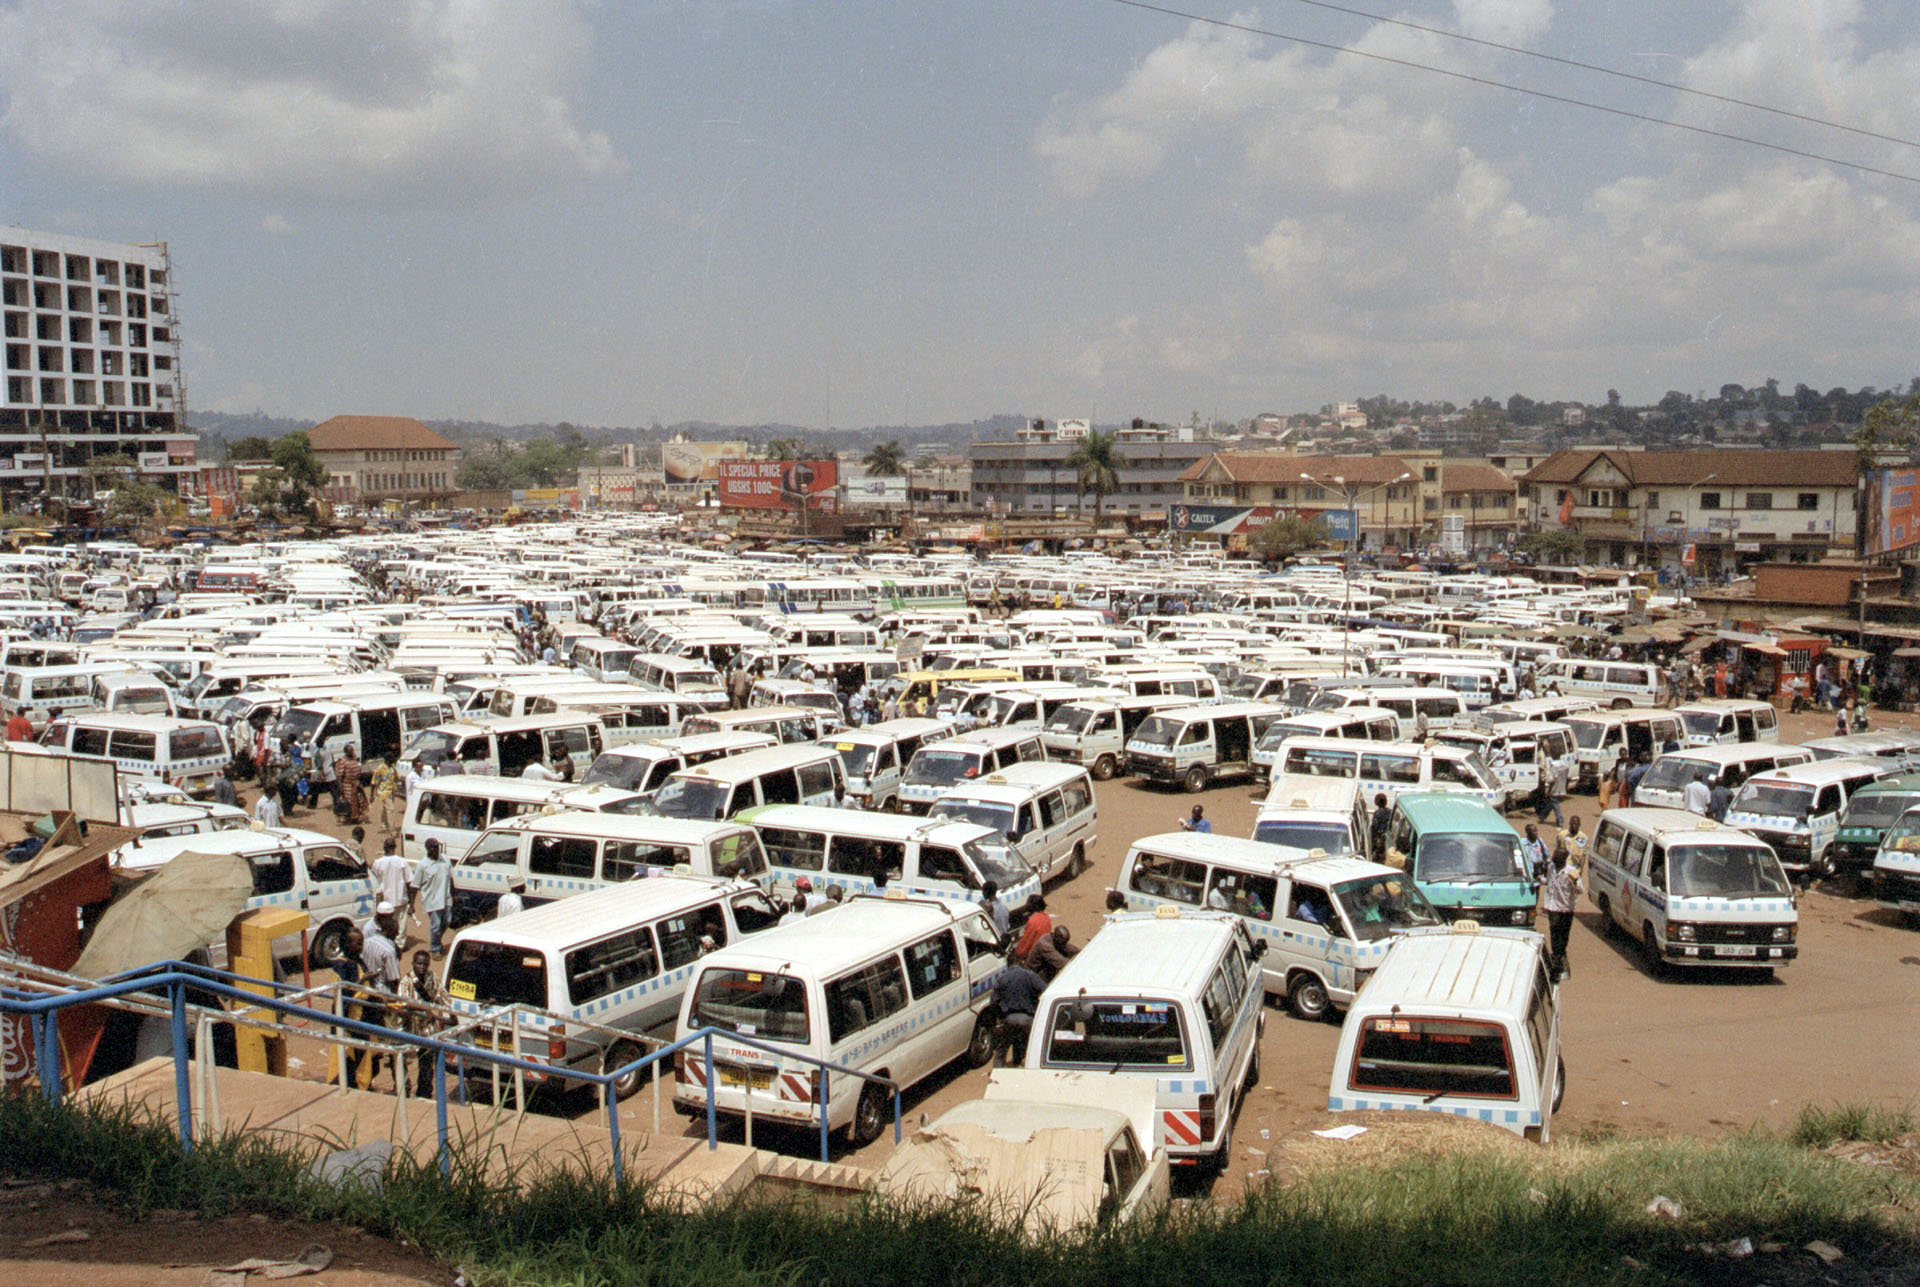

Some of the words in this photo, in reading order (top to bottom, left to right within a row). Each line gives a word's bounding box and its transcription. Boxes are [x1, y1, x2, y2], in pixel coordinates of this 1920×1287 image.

[728, 464, 758, 478] SPECIAL
[759, 464, 781, 478] PRICE
[727, 480, 751, 494] UGSHS
[1190, 513, 1216, 524] CALTEX
[730, 1048, 760, 1059] TRANS
